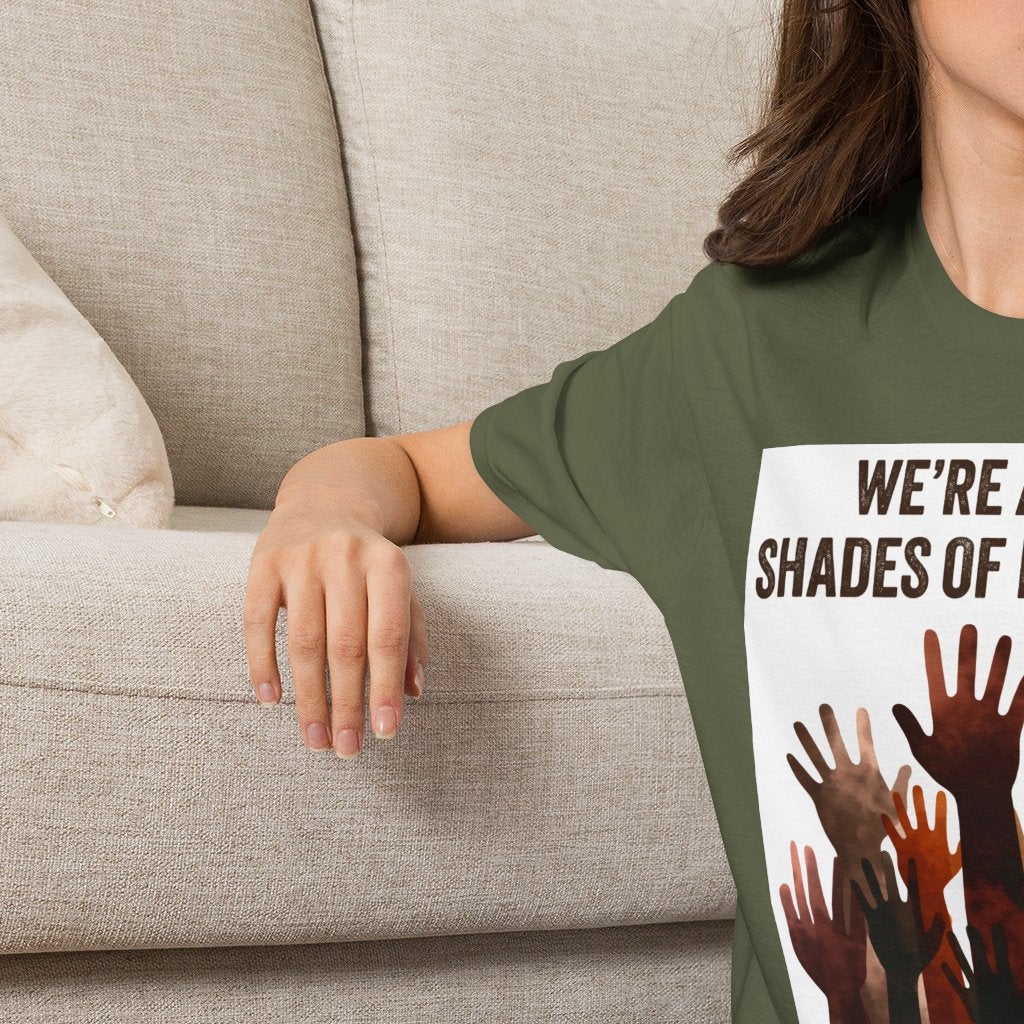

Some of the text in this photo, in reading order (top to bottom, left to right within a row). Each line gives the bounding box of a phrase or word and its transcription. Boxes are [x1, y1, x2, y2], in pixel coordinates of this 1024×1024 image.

[858, 459, 1009, 516] WE’RE
[755, 536, 932, 600] SHADES
[942, 536, 1007, 599] OF
